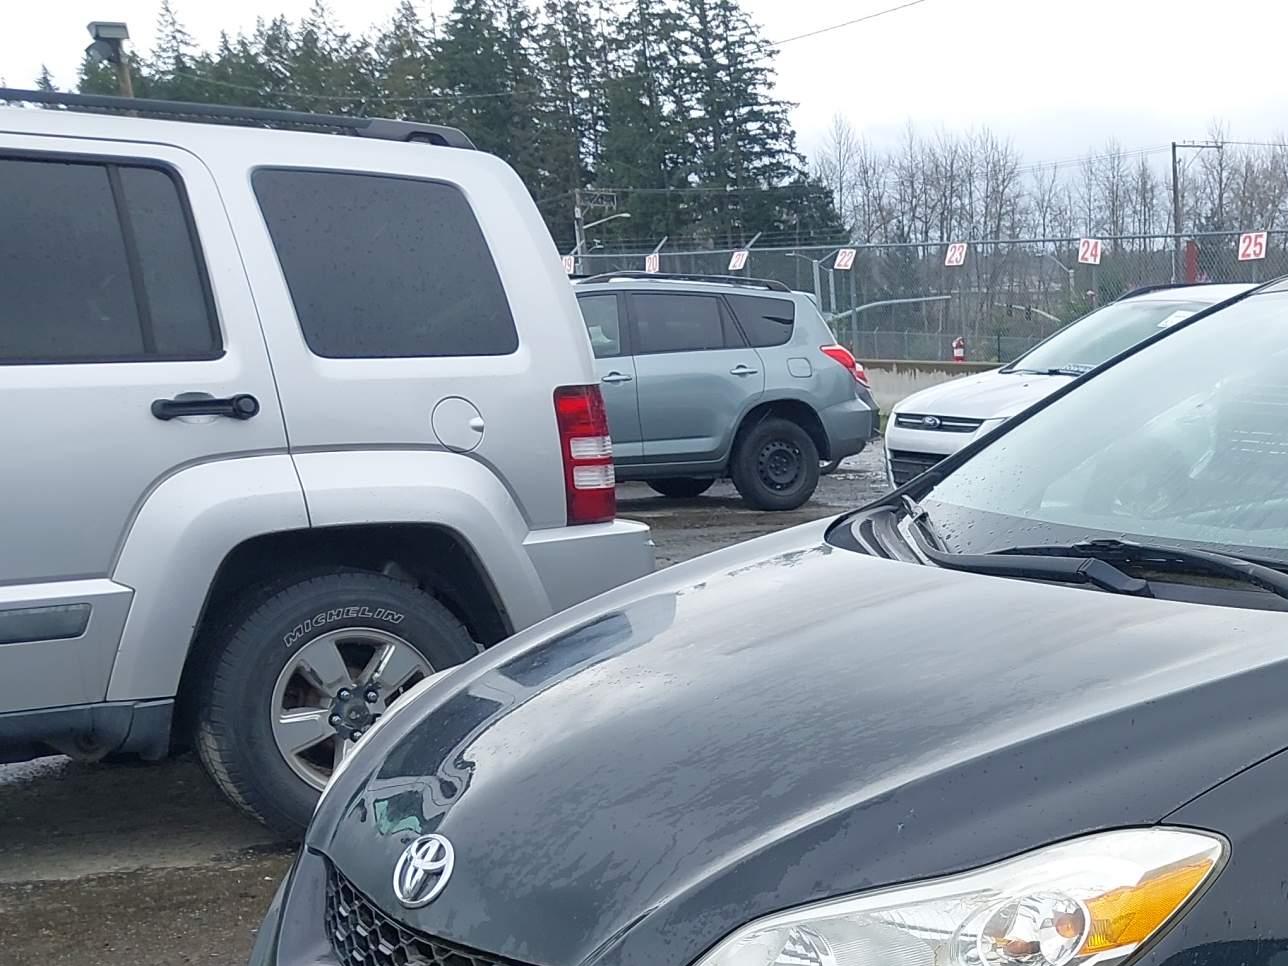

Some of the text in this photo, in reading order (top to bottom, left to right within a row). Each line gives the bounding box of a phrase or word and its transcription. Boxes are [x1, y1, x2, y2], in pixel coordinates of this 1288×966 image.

[947, 244, 966, 264] 23
[1080, 239, 1100, 263] 24
[1241, 233, 1264, 259] 25
[647, 255, 659, 273] 20
[732, 251, 746, 269] 21
[836, 250, 854, 268] 22
[283, 606, 405, 648] MICHELIN
